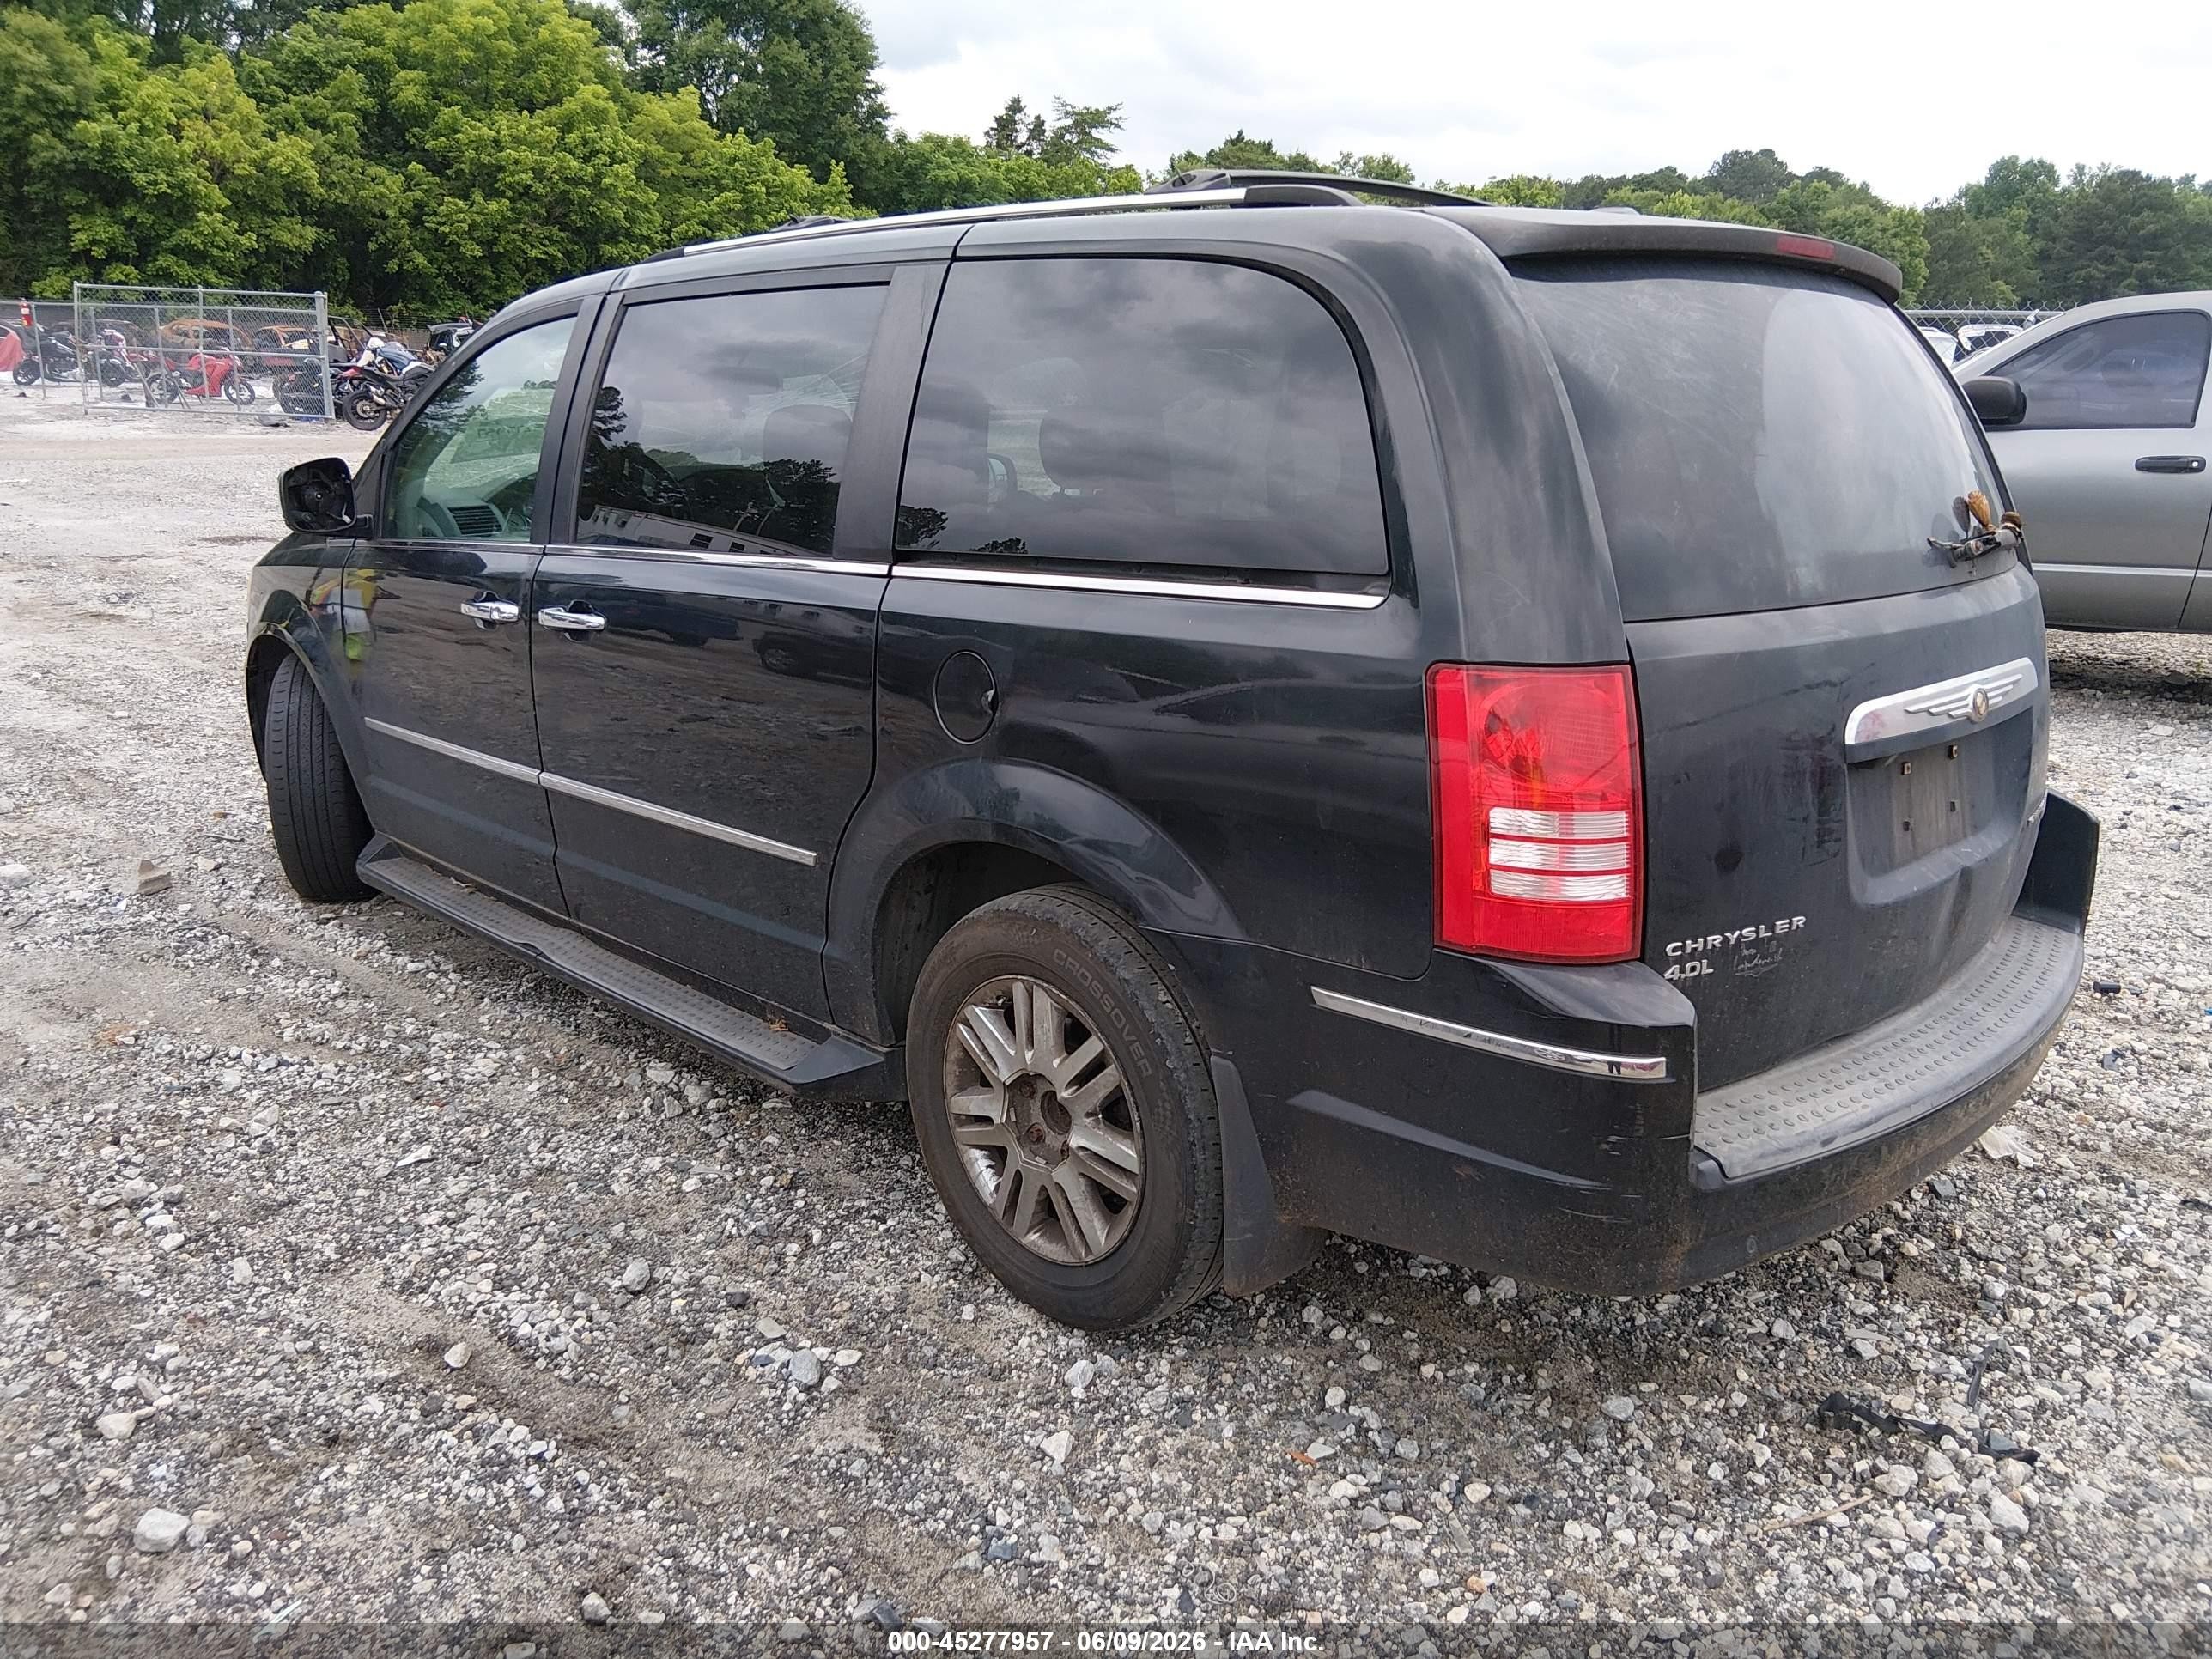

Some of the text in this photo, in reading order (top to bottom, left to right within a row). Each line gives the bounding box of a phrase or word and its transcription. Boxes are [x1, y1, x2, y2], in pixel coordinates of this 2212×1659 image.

[1665, 915, 1807, 957] CHRYSLER
[1662, 959, 1714, 980] 4.0L
[1053, 948, 1152, 1078] CROSSOVER
